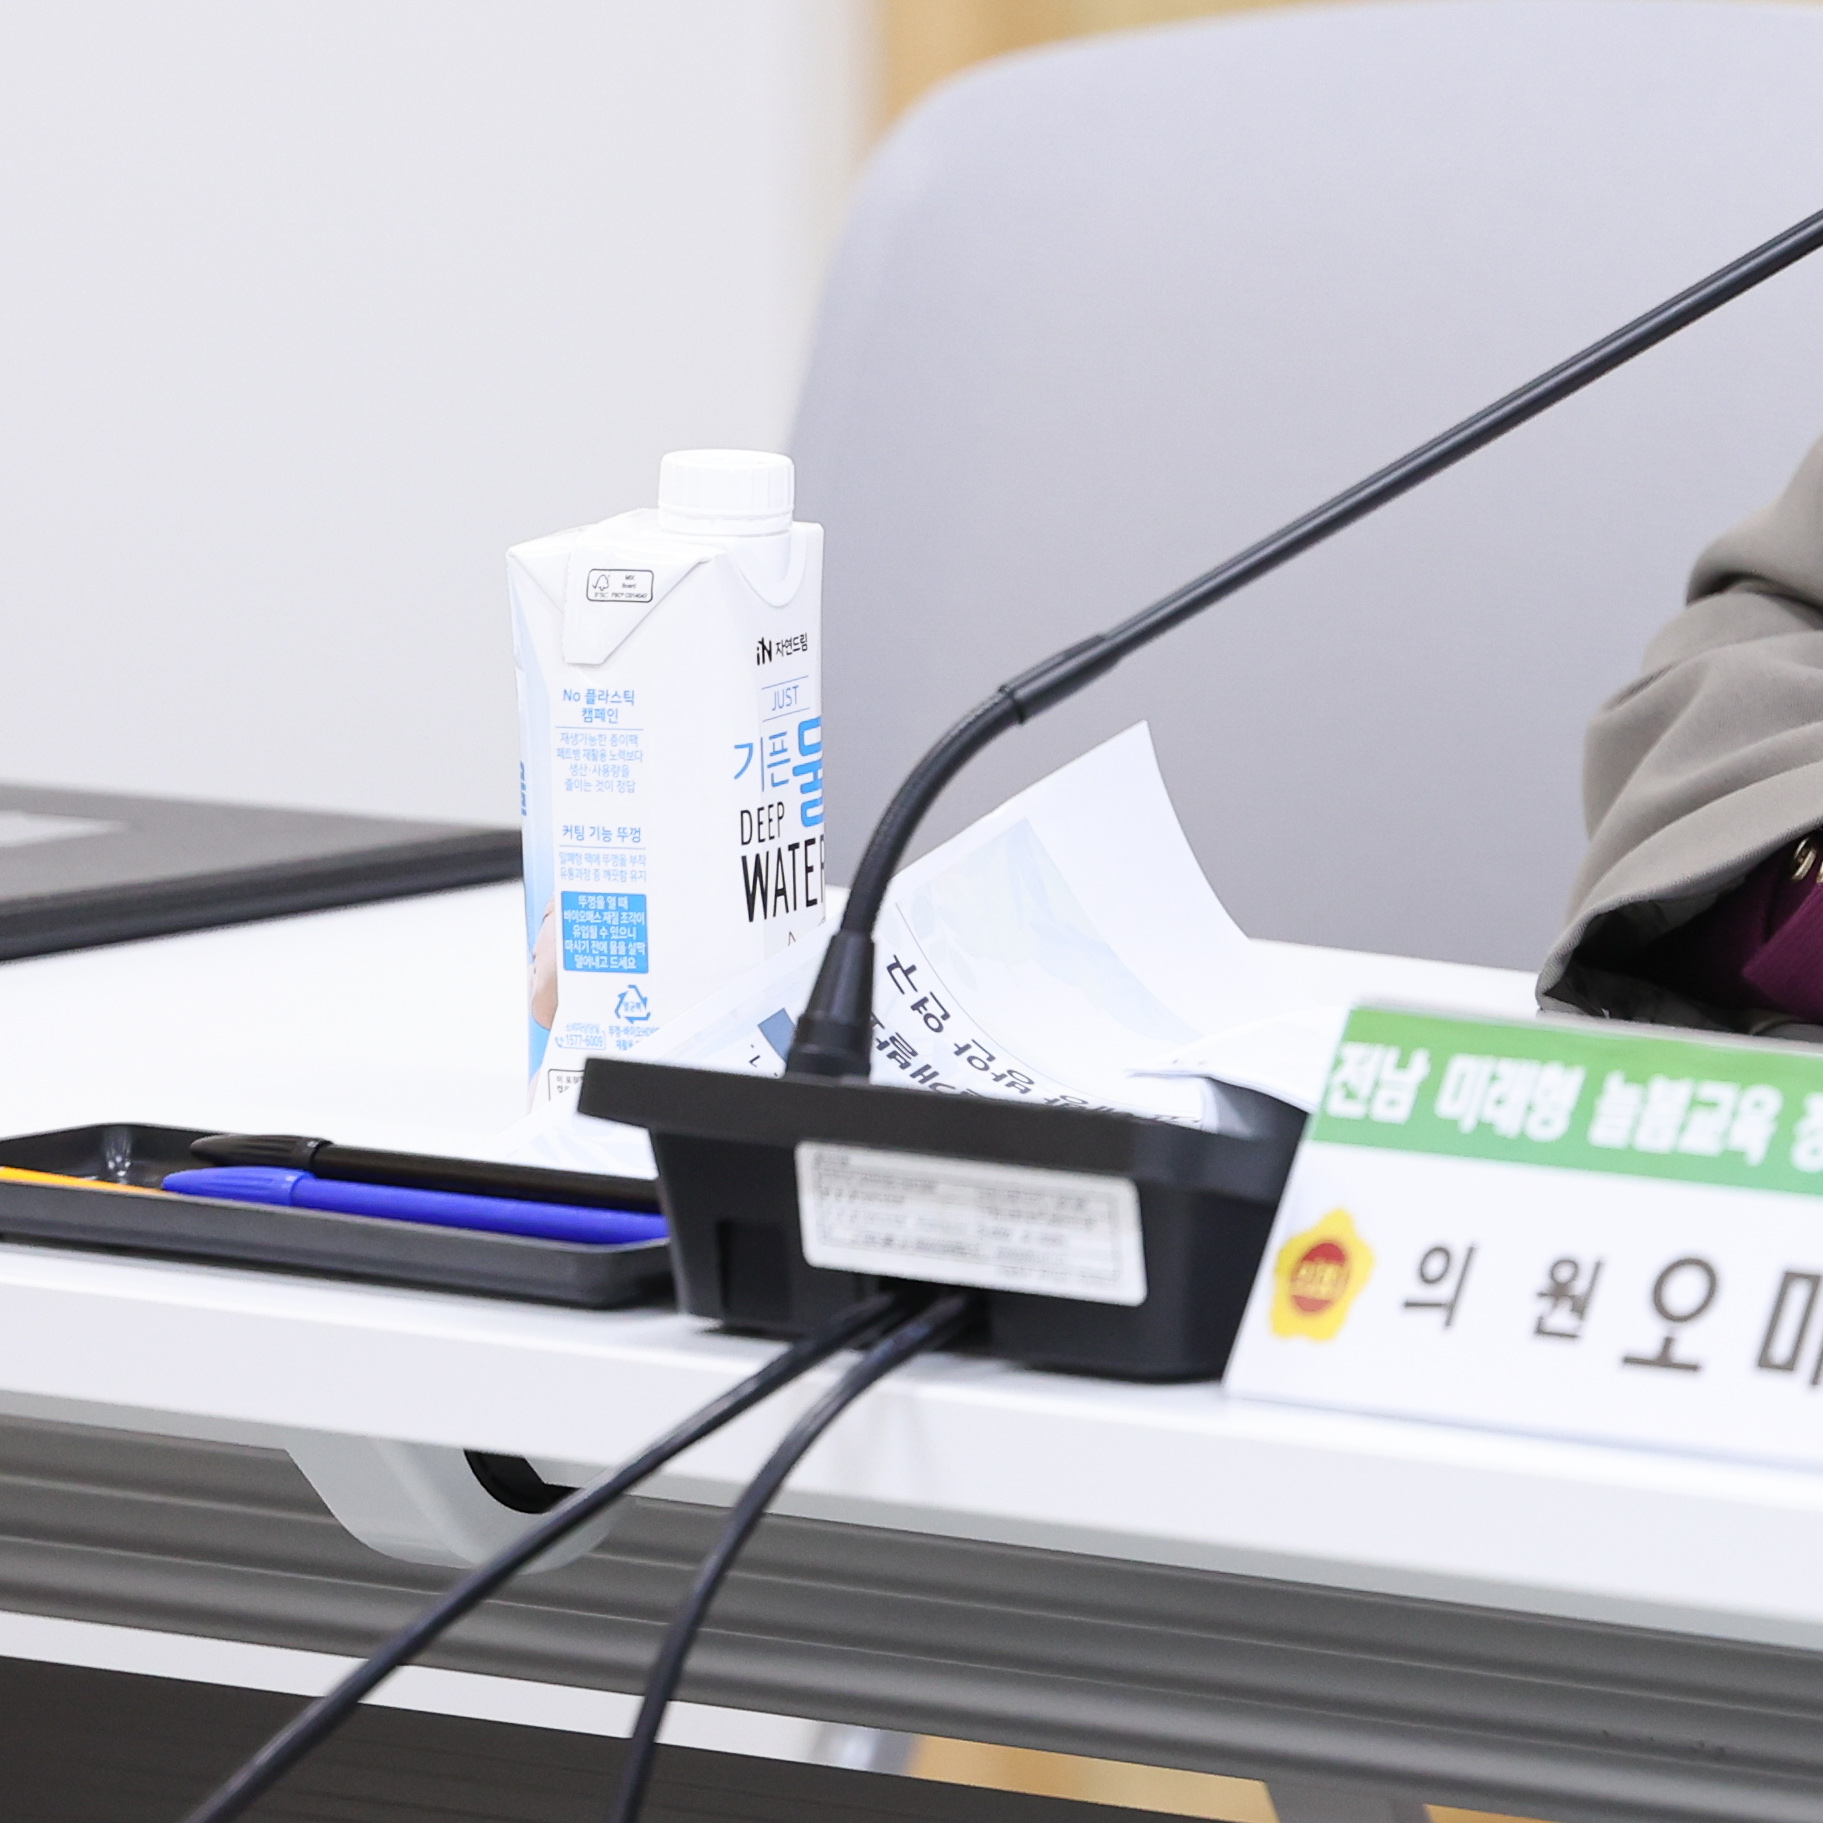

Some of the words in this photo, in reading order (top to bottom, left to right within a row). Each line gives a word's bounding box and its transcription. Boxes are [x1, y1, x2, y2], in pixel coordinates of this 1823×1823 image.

[775, 633, 808, 657] 자연드림
[563, 688, 581, 702] No
[585, 688, 635, 706] 플라스틱
[771, 685, 799, 711] JUST
[582, 708, 619, 724] 캠페인
[560, 732, 607, 747] 재생가능한
[610, 734, 639, 747] 종이팩
[595, 780, 613, 793] 것이
[617, 780, 636, 794] 정답
[740, 801, 785, 846] DEEP
[562, 825, 585, 841] 커팅
[589, 826, 613, 843] 기능
[617, 827, 641, 843] 뚜껑
[599, 926, 609, 939] 수
[610, 956, 637, 970] 드세요
[886, 954, 950, 1033] 연구
[1326, 1042, 1431, 1125] 전남
[1434, 1052, 1587, 1143] 미래형
[1587, 1070, 1784, 1167] 늘봄교육
